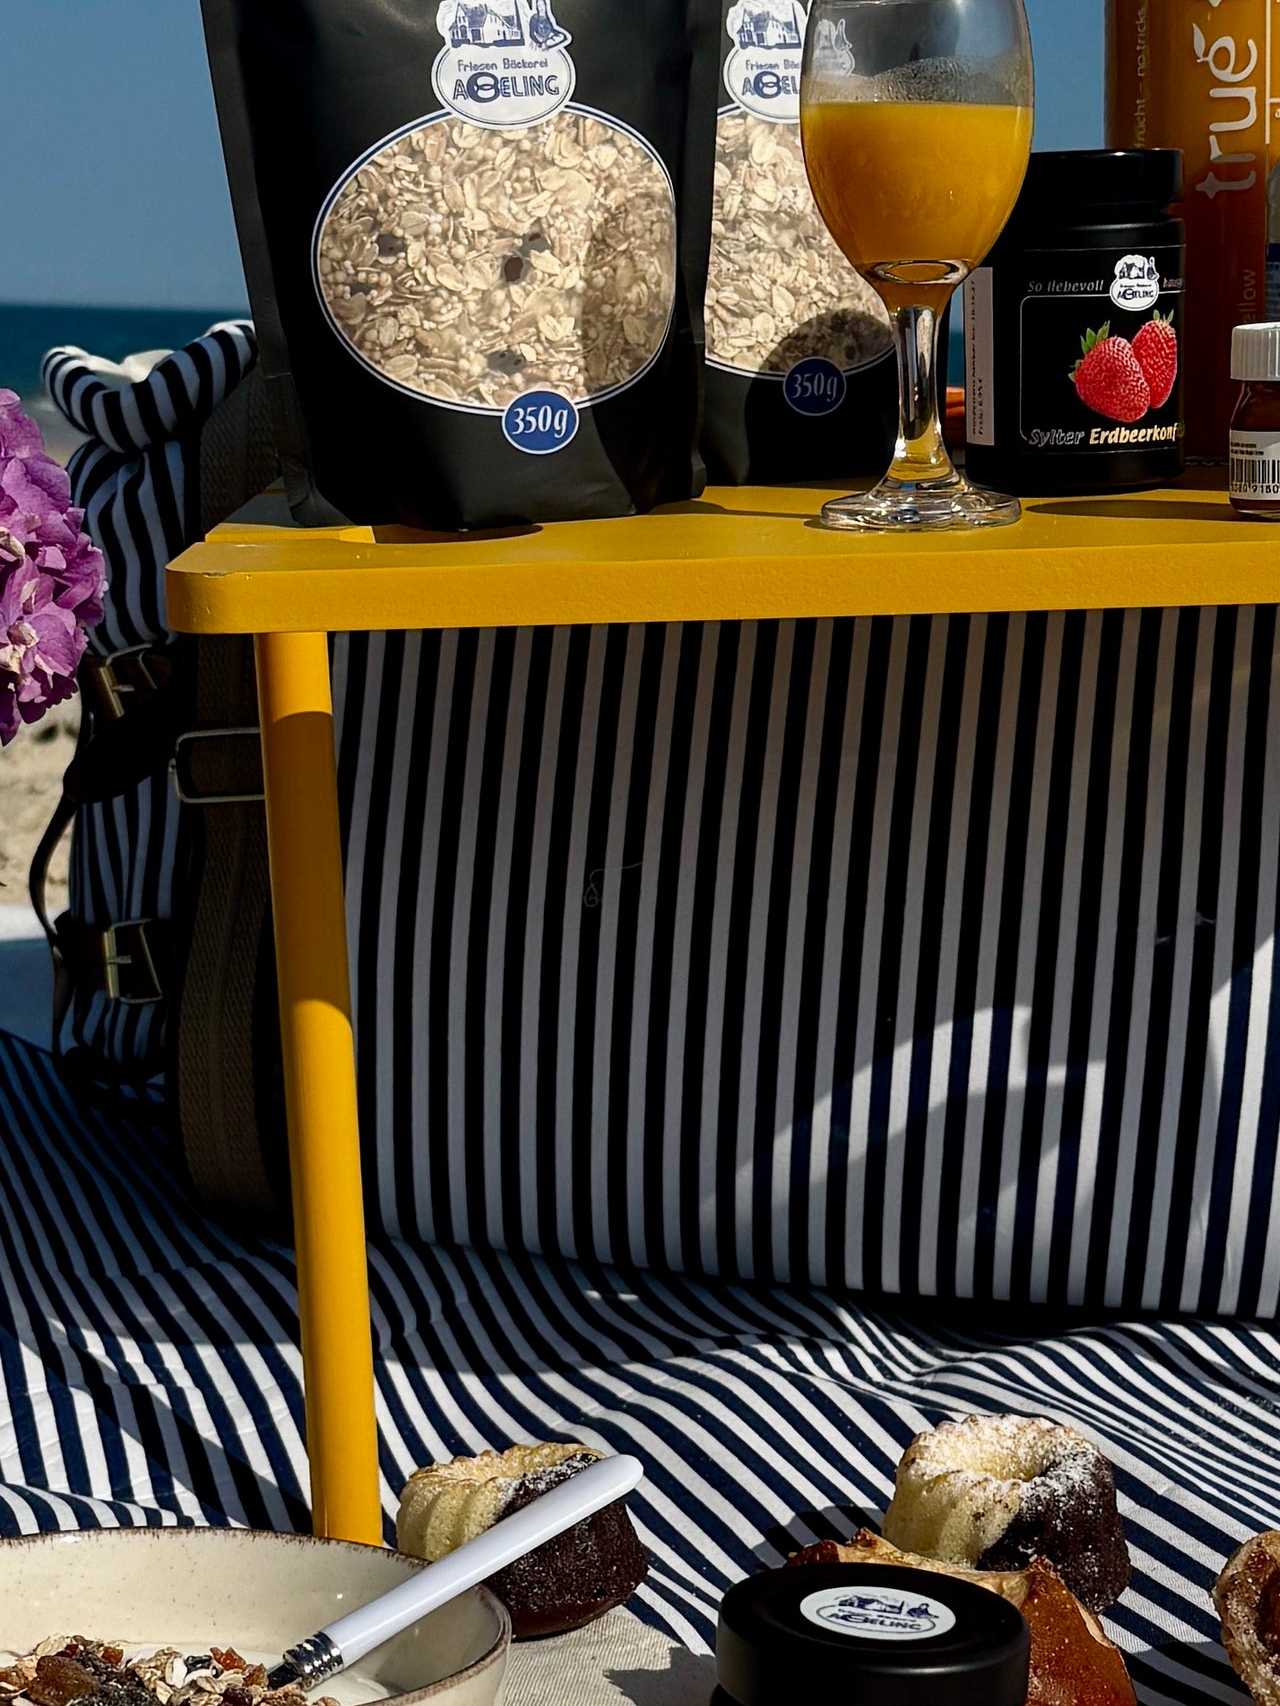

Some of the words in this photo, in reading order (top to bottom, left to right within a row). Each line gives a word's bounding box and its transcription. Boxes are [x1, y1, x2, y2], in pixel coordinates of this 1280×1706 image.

[1194, 35, 1259, 200] true
[1027, 280, 1043, 293] So
[1046, 278, 1104, 293] liebevoll
[1236, 268, 1257, 324] ellow
[791, 372, 838, 402] 350g
[511, 404, 569, 439] 350g
[1028, 428, 1085, 448] Sylter
